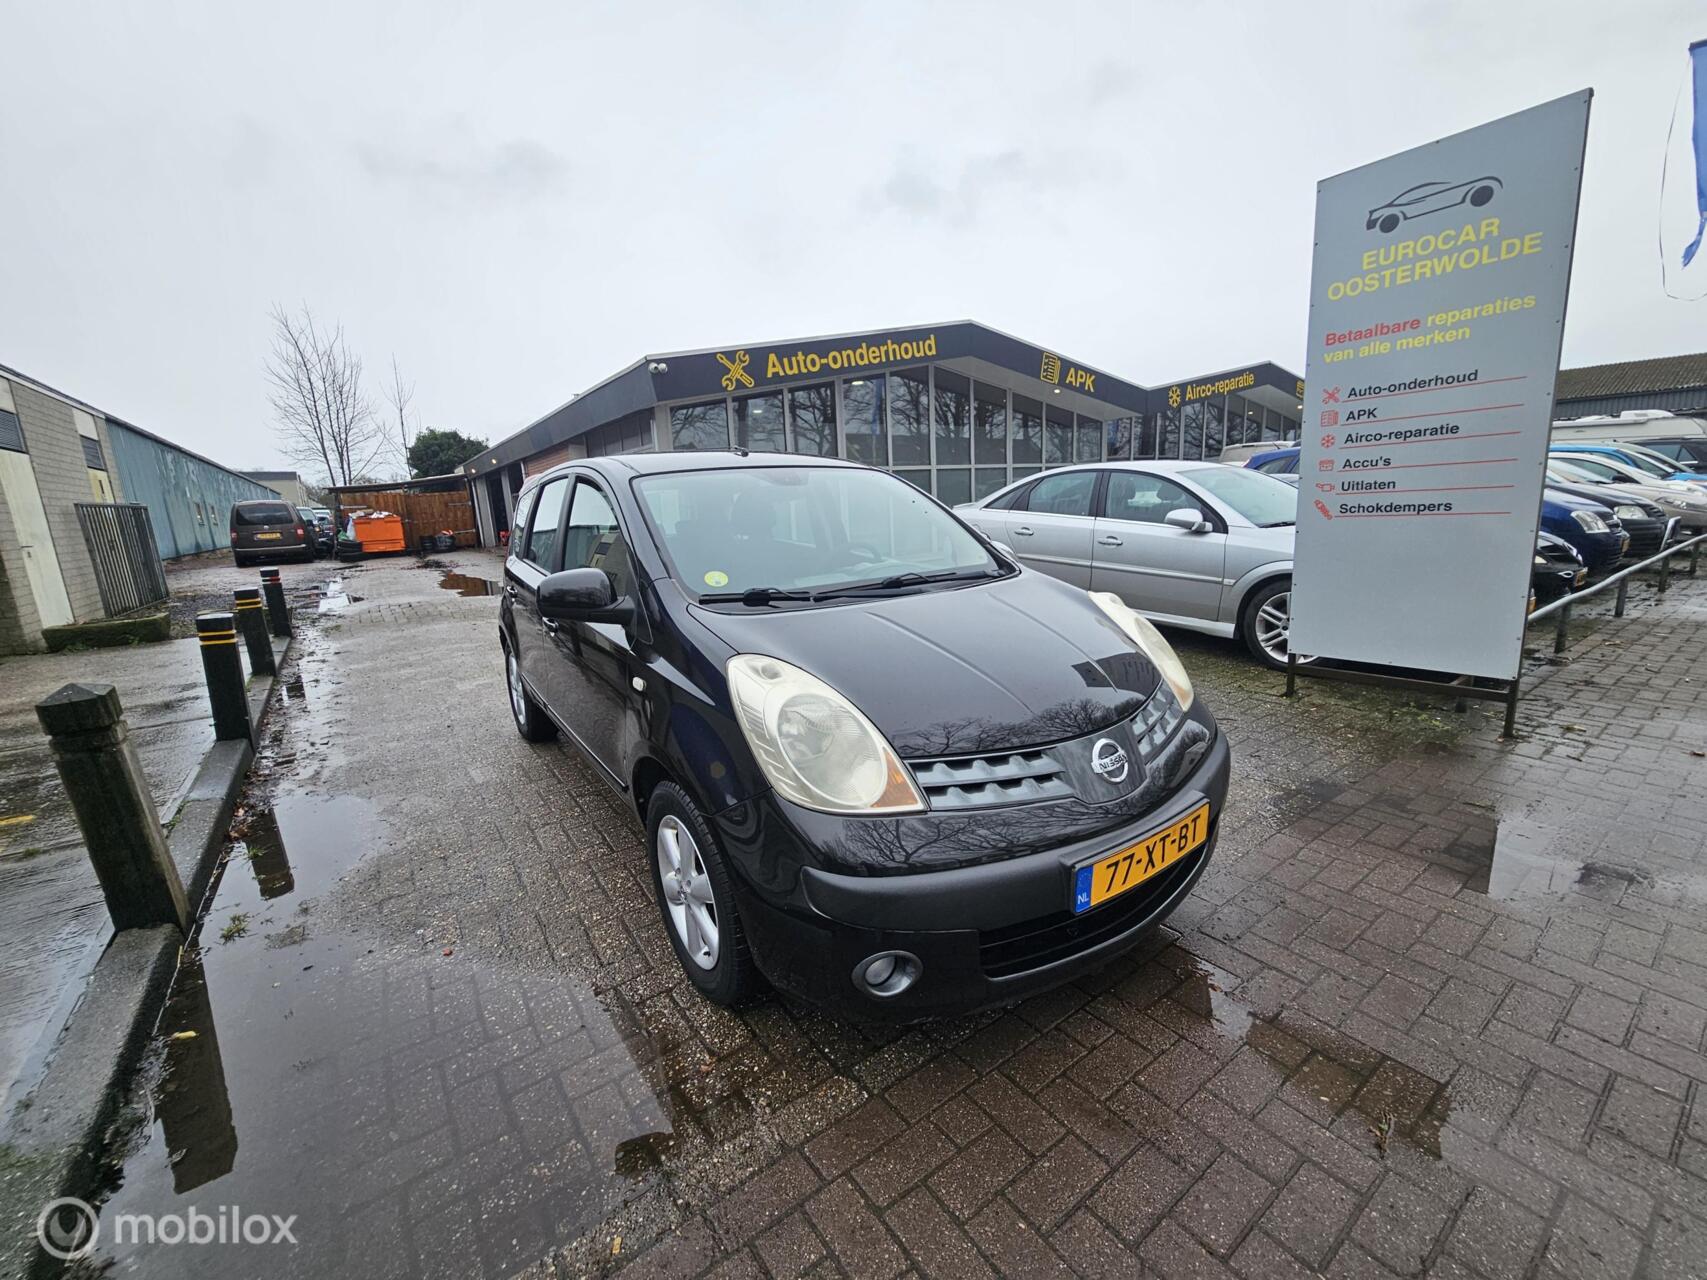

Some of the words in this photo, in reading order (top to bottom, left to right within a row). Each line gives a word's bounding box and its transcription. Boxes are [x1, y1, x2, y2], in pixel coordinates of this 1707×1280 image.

[1362, 217, 1501, 270] EUROCAR
[1327, 232, 1544, 300] OOSTERWOLDE
[1325, 317, 1421, 346] Betaalbare
[1427, 295, 1537, 328] reparaties
[766, 334, 936, 378] Auto-onderhoud
[1323, 347, 1354, 364] van
[1359, 341, 1391, 358] alle
[1396, 326, 1471, 351] merken
[1065, 367, 1097, 393] APK
[1185, 371, 1255, 401] Airco-reparatie
[1347, 369, 1478, 399] Auto-onderhoud
[1345, 408, 1378, 422] APK
[1344, 423, 1460, 445] Airco-reparatie
[1342, 456, 1392, 470] Accu's
[1341, 479, 1396, 492] Uitlaten
[1339, 501, 1453, 515] Schokdempers
[1099, 753, 1127, 770] NISSAN
[1105, 814, 1201, 894] 77-XT-BT
[1077, 892, 1090, 905] NL
